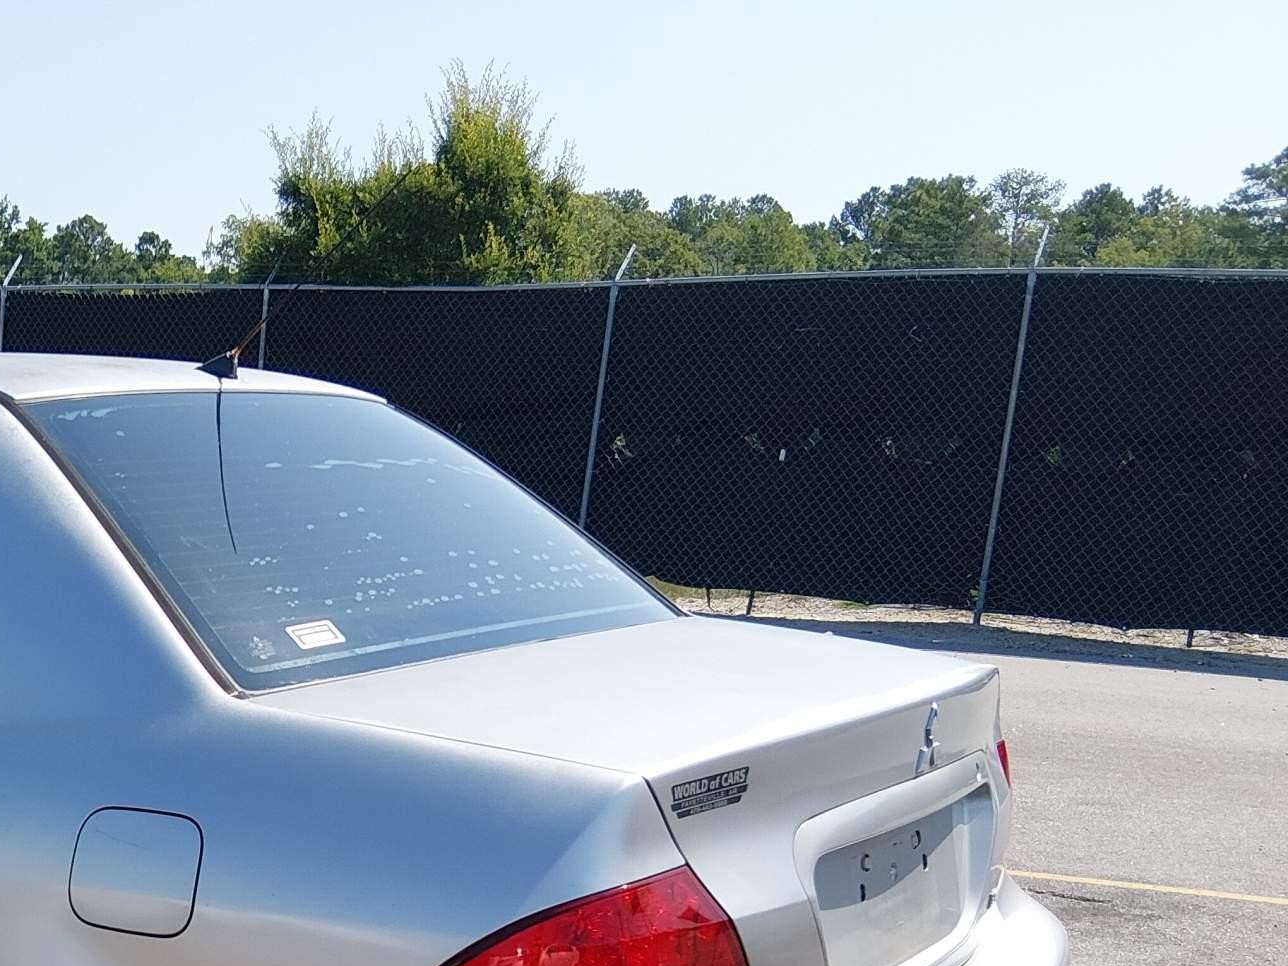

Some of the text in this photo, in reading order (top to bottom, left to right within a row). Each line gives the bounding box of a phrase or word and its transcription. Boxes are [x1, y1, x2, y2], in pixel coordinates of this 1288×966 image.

[673, 768, 746, 800] WORLD of CARS
